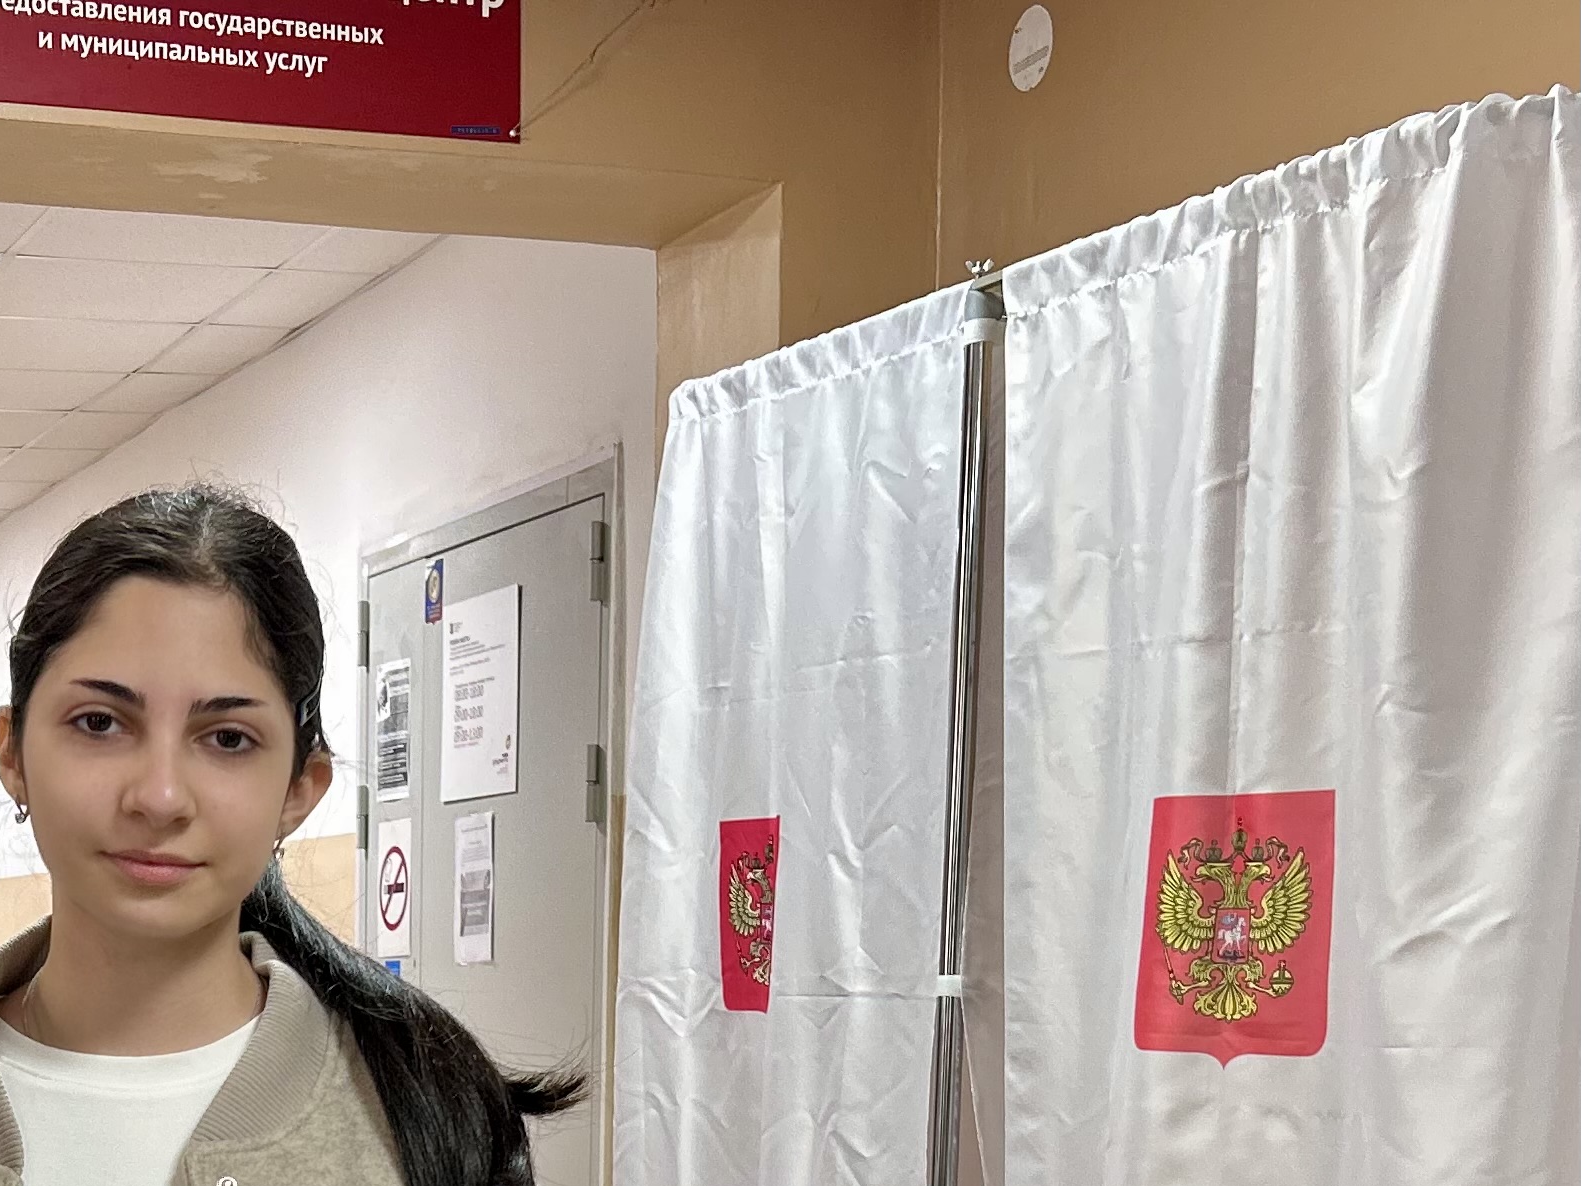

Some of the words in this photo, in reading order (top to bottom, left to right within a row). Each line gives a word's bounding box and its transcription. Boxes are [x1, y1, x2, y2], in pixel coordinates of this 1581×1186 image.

[178, 9, 384, 45] государственных
[38, 31, 53, 49] и
[60, 33, 259, 68] муниципальных
[264, 51, 328, 78] услуг
